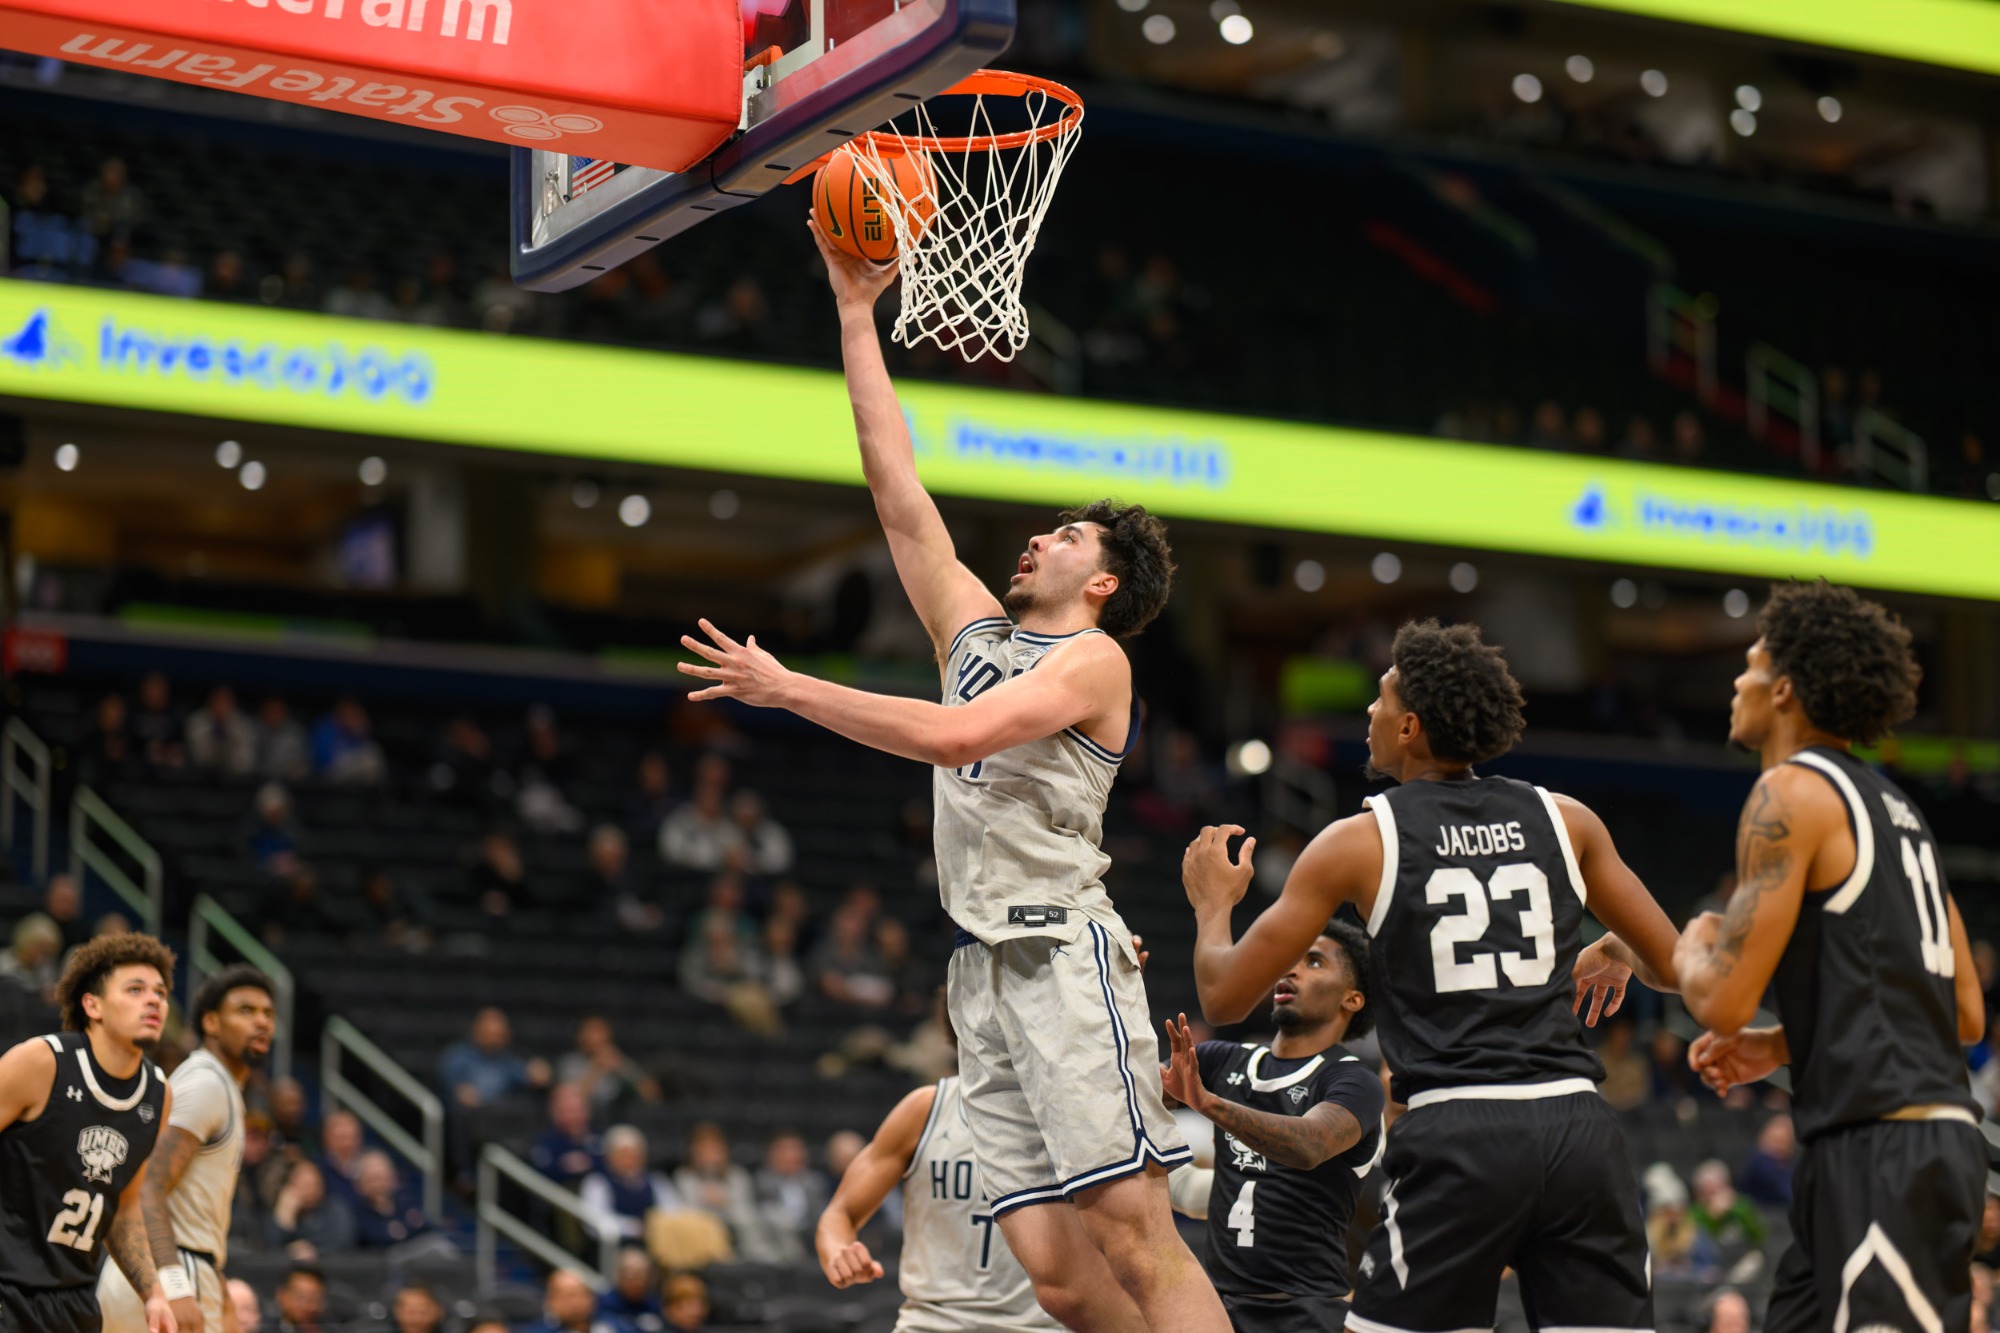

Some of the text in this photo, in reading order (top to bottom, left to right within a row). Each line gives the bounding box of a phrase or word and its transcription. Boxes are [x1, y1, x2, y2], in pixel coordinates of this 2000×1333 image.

[862, 177, 882, 241] ELITE
[950, 651, 1025, 702] HO
[1436, 821, 1526, 856] JACOBS
[1048, 910, 1059, 919] 52
[1425, 862, 1556, 994] 23
[1900, 835, 1955, 979] 11
[79, 1127, 128, 1164] UMBC
[931, 1160, 988, 1201] HO
[46, 1187, 105, 1252] 21
[1227, 1180, 1257, 1248] 4
